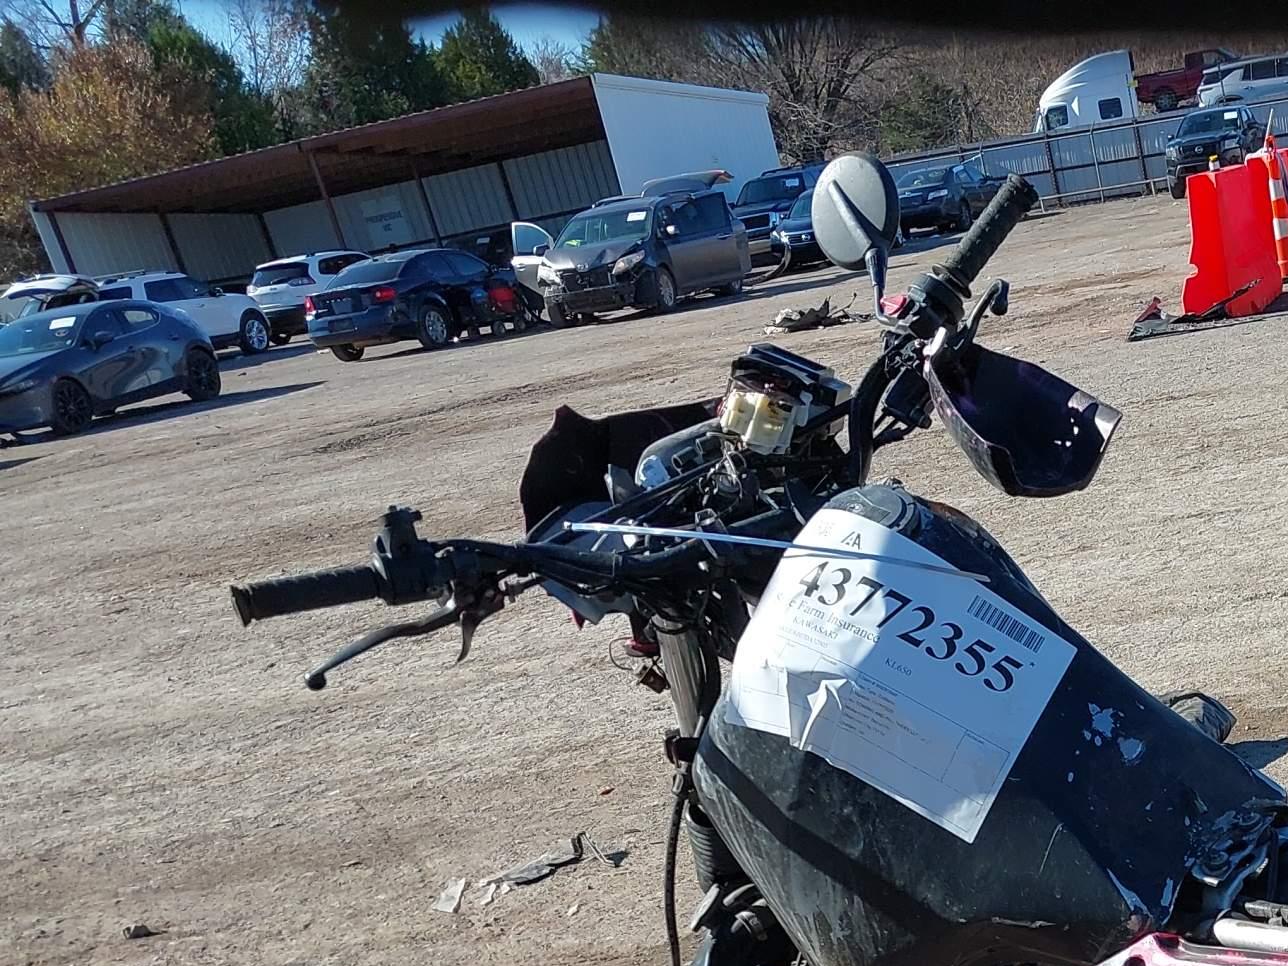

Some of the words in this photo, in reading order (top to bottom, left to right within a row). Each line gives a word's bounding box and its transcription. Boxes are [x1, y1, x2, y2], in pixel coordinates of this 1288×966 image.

[793, 616, 839, 640] KAWASAKI
[797, 600, 825, 620] Farm
[827, 612, 880, 644] Insurance
[798, 560, 1024, 693] 43772355
[885, 657, 912, 676] KL650
